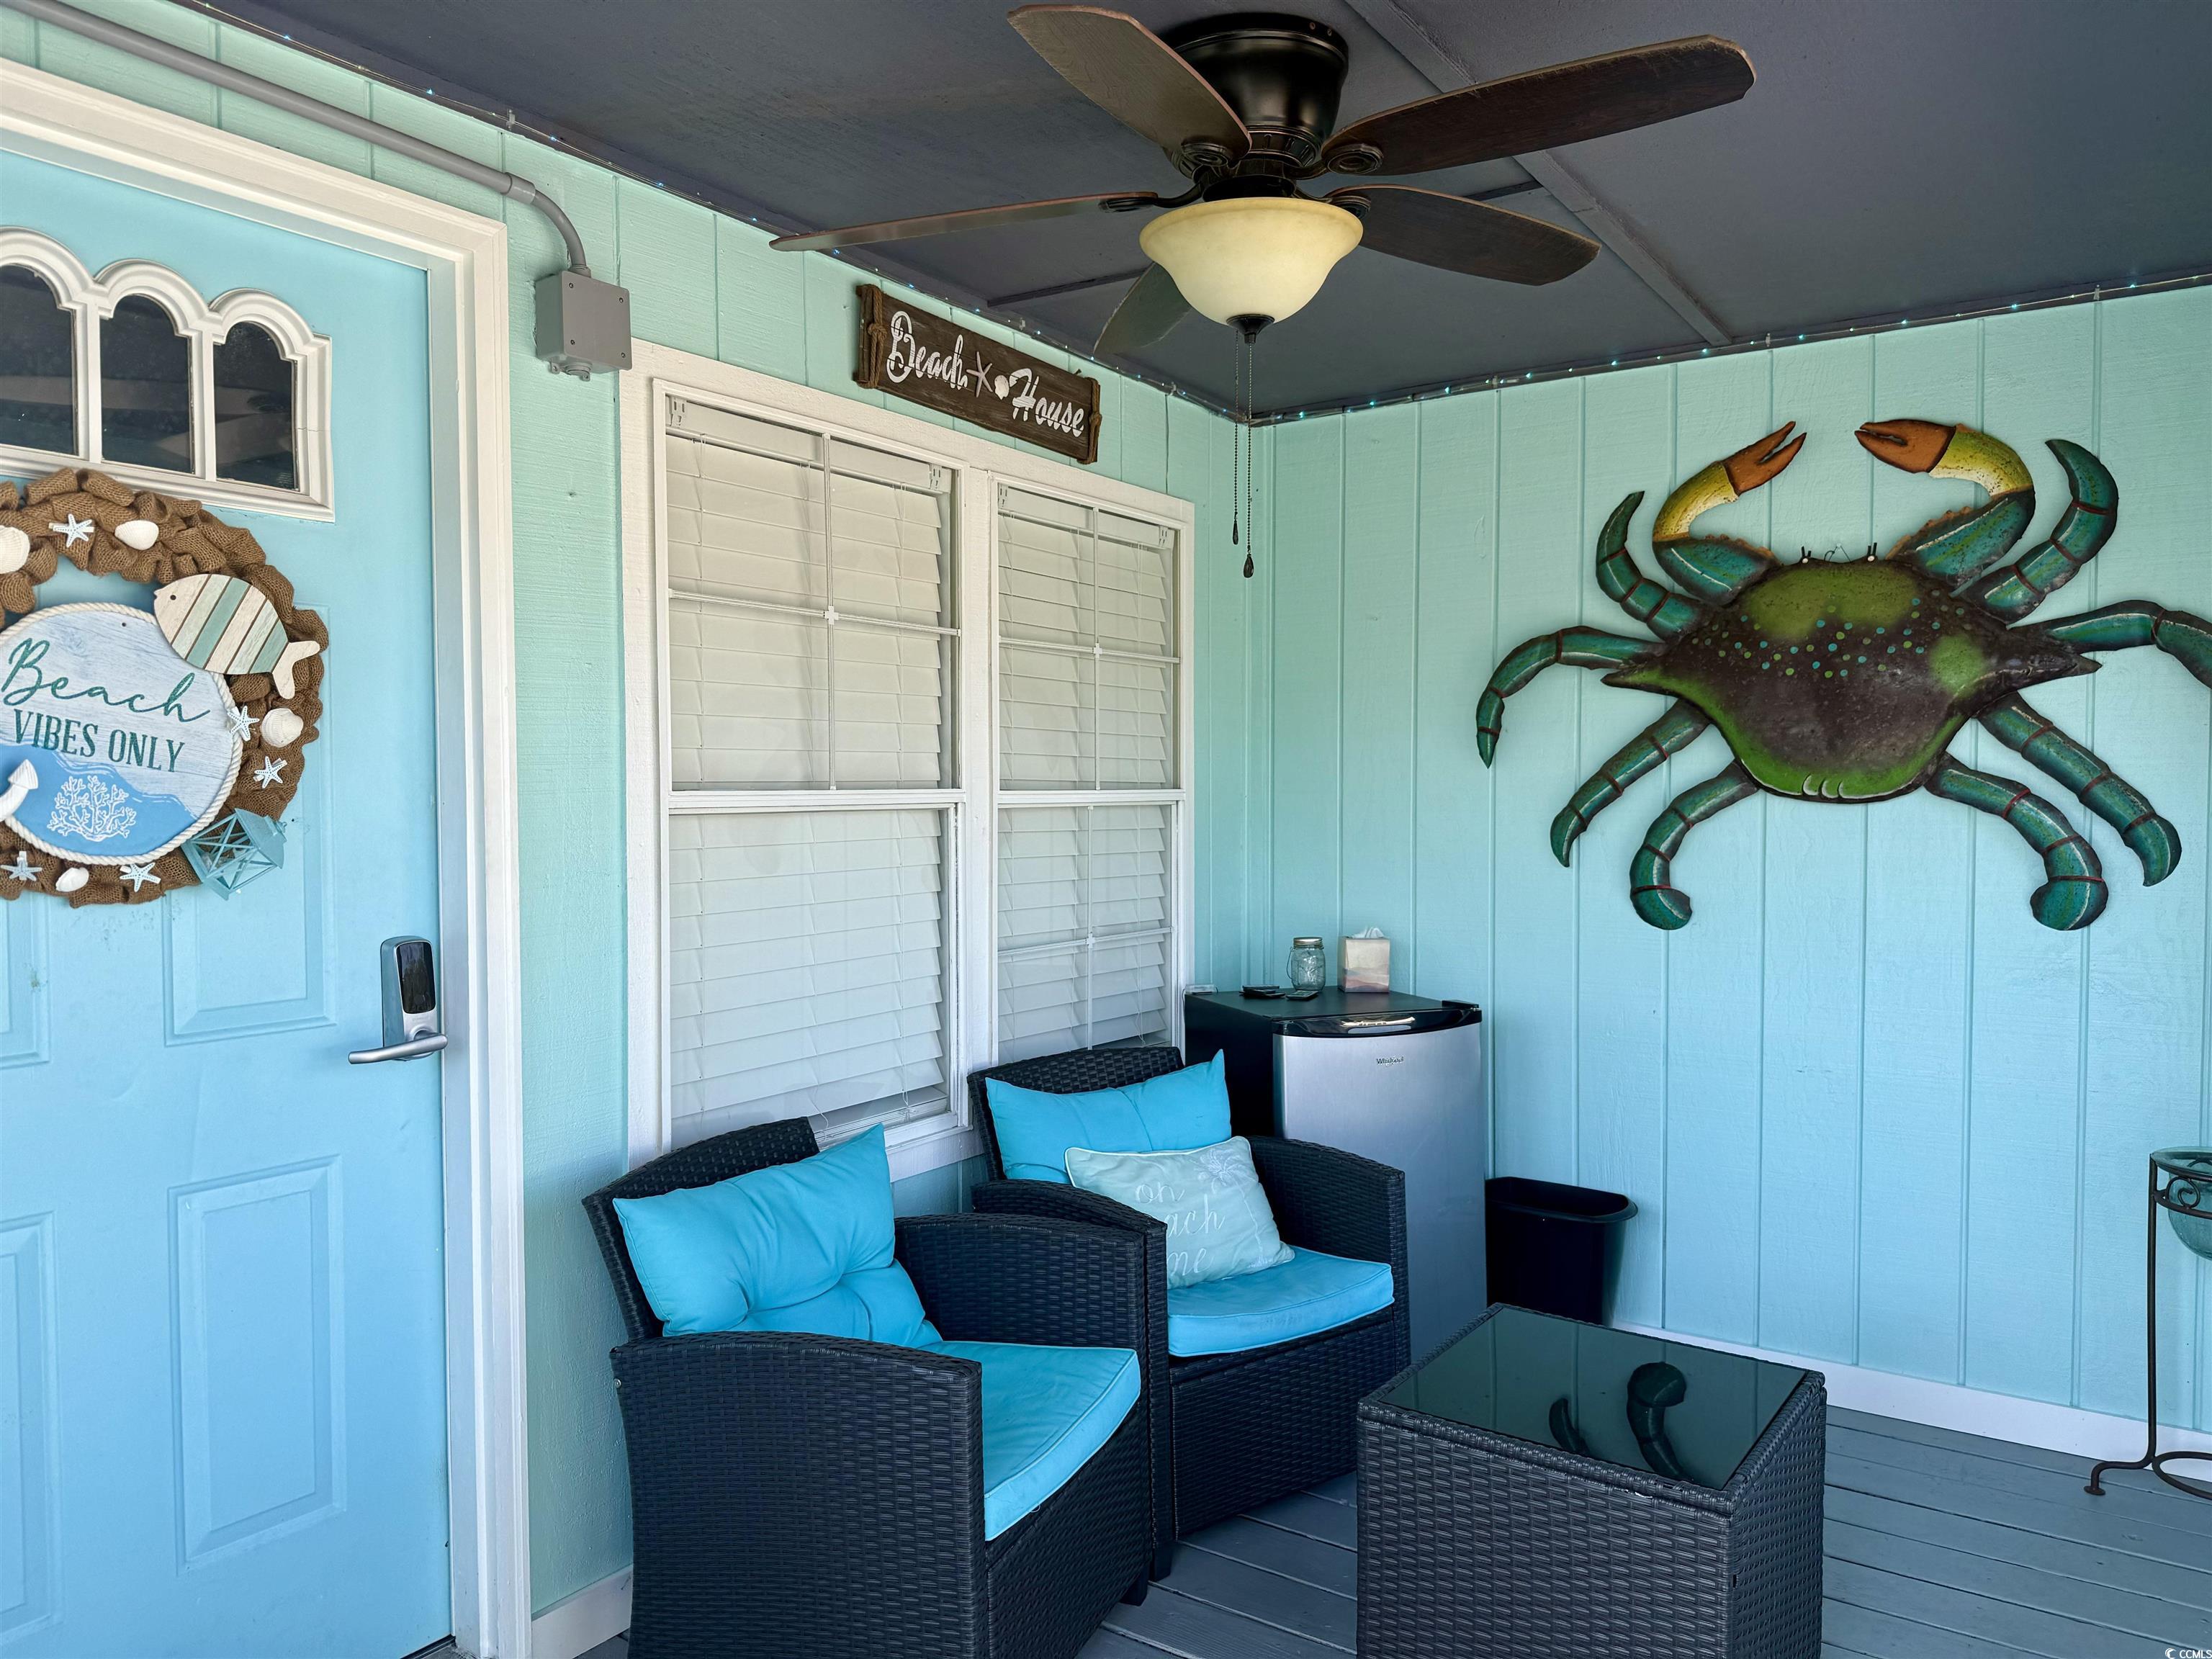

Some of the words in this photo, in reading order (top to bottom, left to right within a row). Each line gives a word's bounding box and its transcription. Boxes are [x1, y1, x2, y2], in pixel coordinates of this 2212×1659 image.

[886, 311, 968, 390] Beach
[1009, 368, 1085, 437] House
[1, 638, 210, 722] Beach
[14, 709, 98, 757] VIBES
[108, 729, 185, 772] ONLY
[1136, 1181, 1185, 1204] on
[1164, 1193, 1226, 1238] ach
[1167, 1247, 1214, 1276] me
